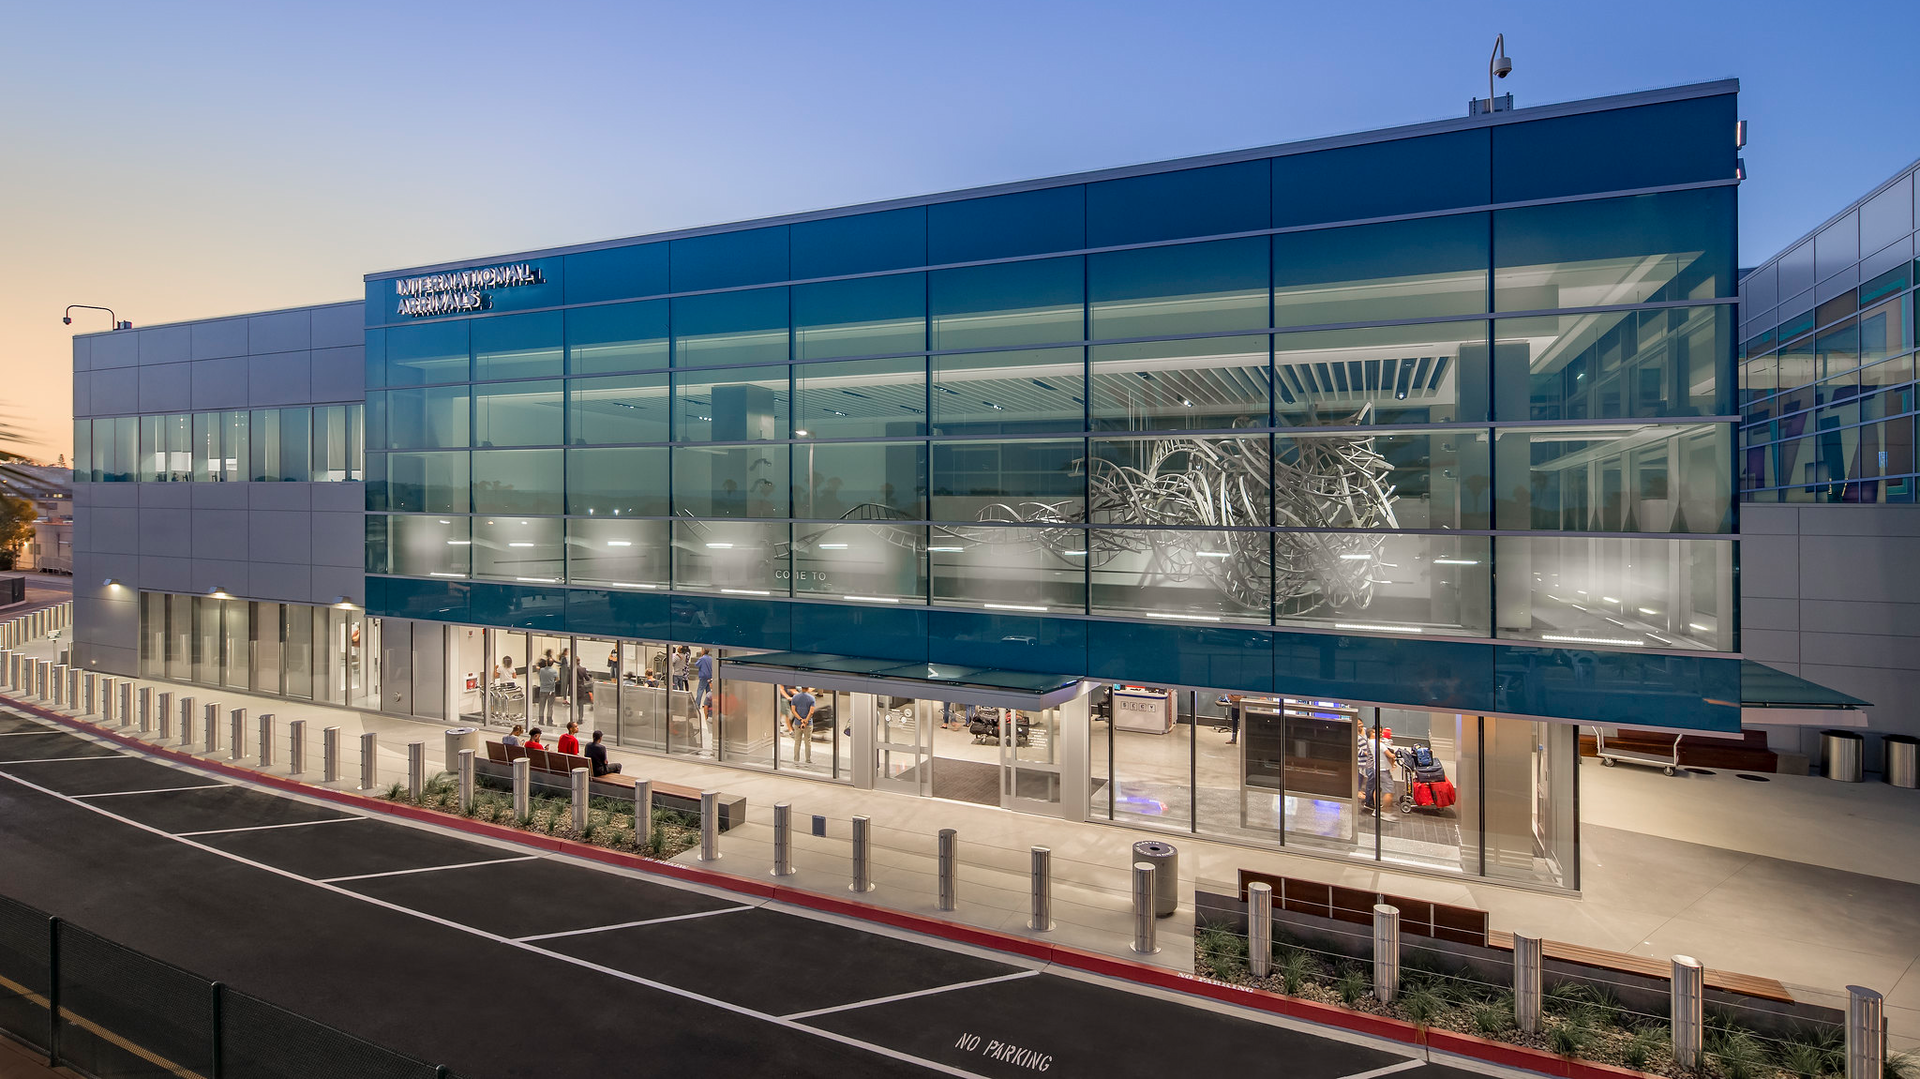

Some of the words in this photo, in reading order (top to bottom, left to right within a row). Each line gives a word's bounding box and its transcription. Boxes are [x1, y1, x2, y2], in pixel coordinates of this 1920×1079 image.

[396, 263, 533, 295] INTERNATIONAL
[397, 289, 481, 315] ARRIVALS
[812, 571, 826, 581] TO
[955, 1032, 981, 1052] NO
[982, 1039, 1053, 1072] PARKING
